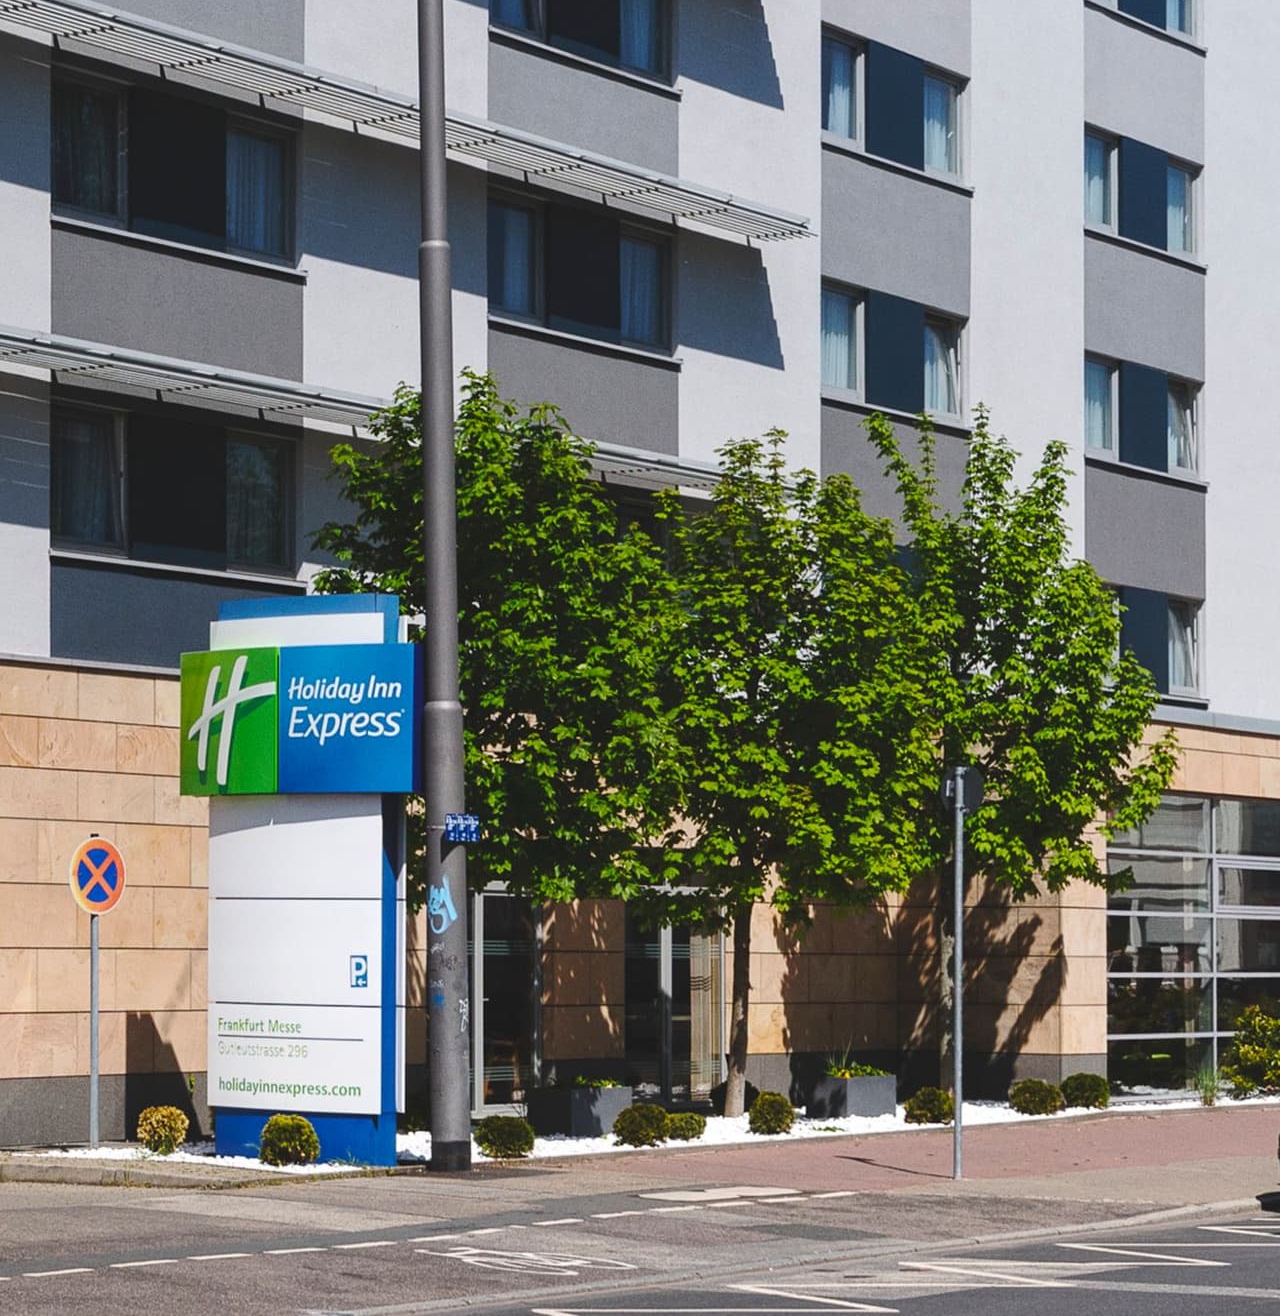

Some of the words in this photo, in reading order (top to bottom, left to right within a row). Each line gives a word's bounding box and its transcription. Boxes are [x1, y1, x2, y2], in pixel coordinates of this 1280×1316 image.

[288, 676, 366, 704] Holiday
[368, 675, 402, 698] Inn
[288, 706, 402, 746] Express
[351, 957, 367, 986] P
[218, 1017, 264, 1032] Frankfurt
[268, 1019, 302, 1033] Messe
[287, 1044, 308, 1058] 296
[218, 1075, 362, 1097] holidayinnexpress.com
